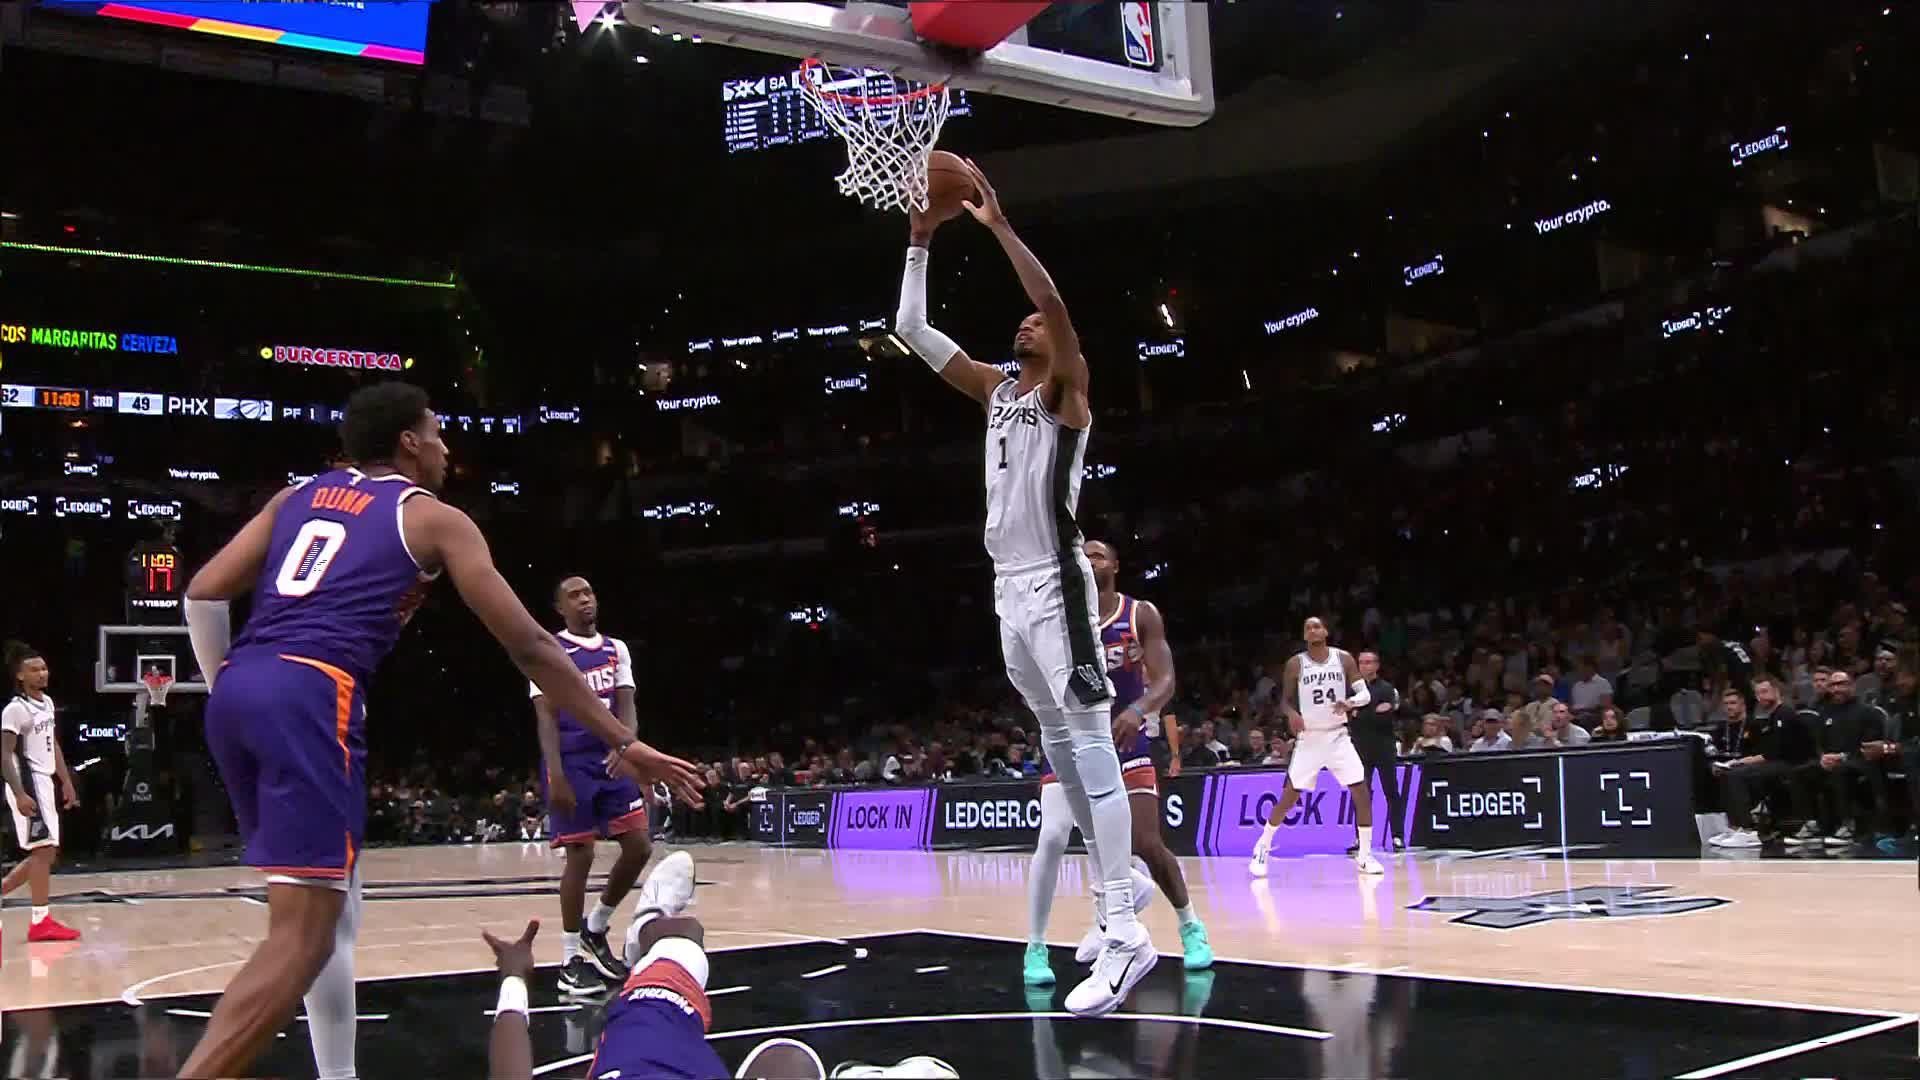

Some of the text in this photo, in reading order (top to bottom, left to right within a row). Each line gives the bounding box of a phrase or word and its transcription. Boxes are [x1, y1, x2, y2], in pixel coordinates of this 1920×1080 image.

[1739, 134, 1780, 158] LEDGER
[1535, 199, 1611, 234] Your crypto.
[1264, 306, 1319, 335] Your crypto.
[1668, 317, 1696, 333] LEDGER
[31, 327, 117, 350] MARGARITAS
[121, 333, 178, 354] CERVEZA
[1145, 343, 1178, 355] LEDGER
[273, 346, 402, 370] BURGERTECA
[831, 378, 861, 389] LEDGER
[42, 391, 81, 407] 11:03
[92, 395, 113, 407] 3RD
[132, 396, 150, 411] 49
[168, 397, 209, 415] PHX
[656, 394, 721, 411] Your crypto.
[283, 407, 301, 419] PF
[545, 412, 575, 420] LEDGER
[992, 405, 1038, 428] PURS
[998, 436, 1008, 469] 1
[168, 468, 220, 481] Your crypto.
[63, 501, 104, 513] LEDGER
[135, 503, 174, 516] LEDGER
[311, 486, 375, 516] DUNN
[142, 553, 174, 568] 11:03
[276, 518, 346, 597] 0
[149, 568, 173, 592] 17
[1312, 688, 1337, 705] 24
[1446, 792, 1526, 818] LEDGER
[793, 811, 820, 825] LEDGER
[847, 804, 913, 830] LOCK IN
